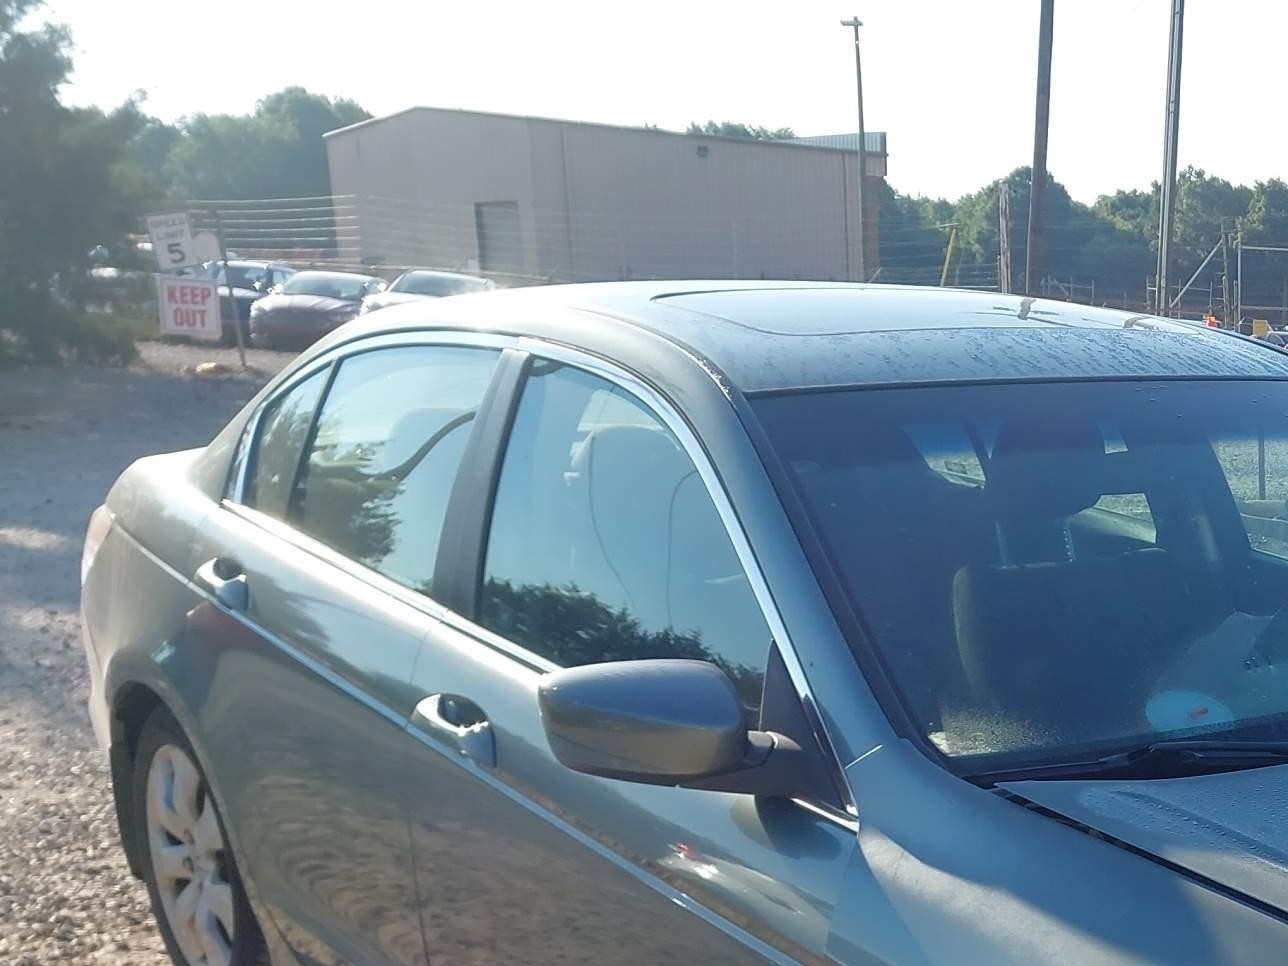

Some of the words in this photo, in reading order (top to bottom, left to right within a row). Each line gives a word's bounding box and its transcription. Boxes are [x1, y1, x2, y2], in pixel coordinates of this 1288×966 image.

[167, 242, 186, 263] 5
[167, 286, 210, 305] KEEP
[173, 308, 207, 328] OUT
